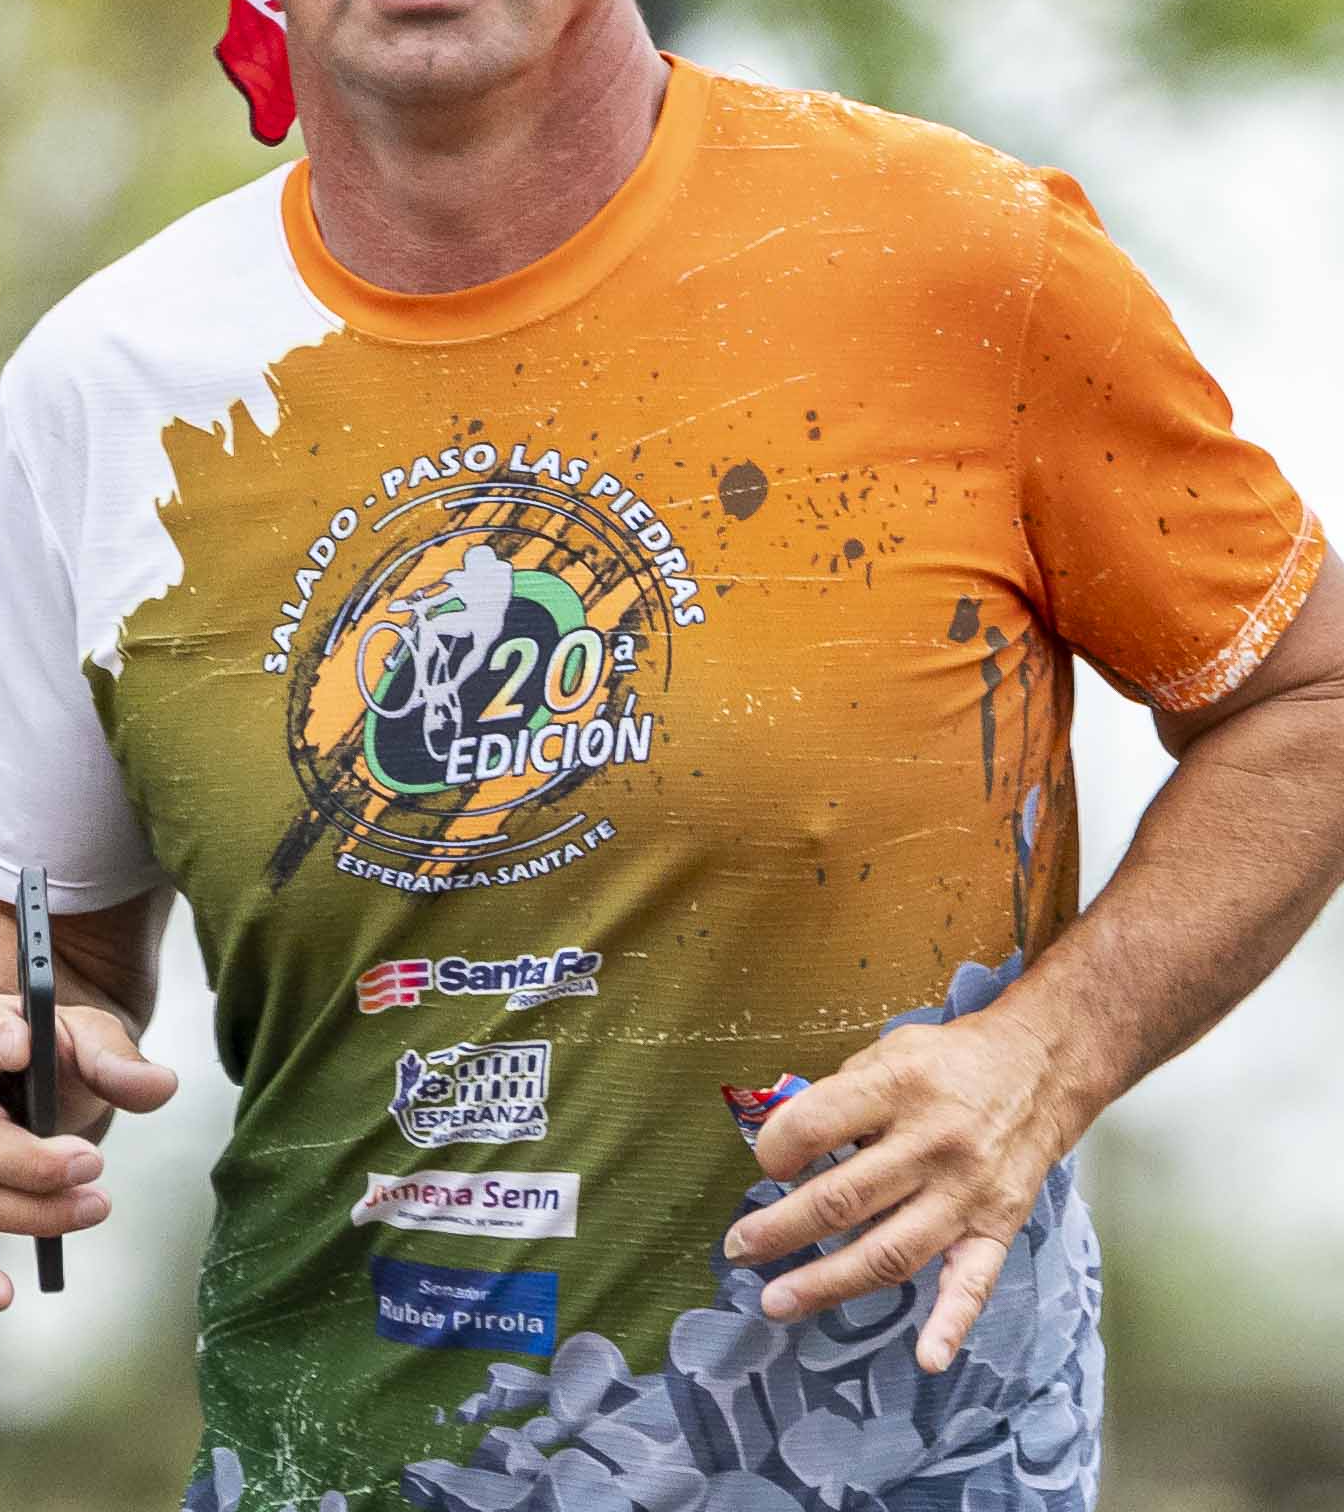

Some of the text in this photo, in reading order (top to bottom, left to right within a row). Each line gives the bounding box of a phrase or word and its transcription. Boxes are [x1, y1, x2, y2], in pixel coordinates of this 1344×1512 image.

[263, 506, 359, 674] SALADO
[381, 442, 497, 500] PASO
[509, 443, 589, 486] LAS
[589, 472, 706, 627] PIEDRAS
[445, 693, 654, 785] EDICIÓN
[585, 818, 618, 849] FE
[439, 951, 598, 991] Santa Fe
[414, 1105, 545, 1128] ESPERANZA
[482, 1181, 561, 1209] Senn
[453, 1311, 545, 1335] Pirola
